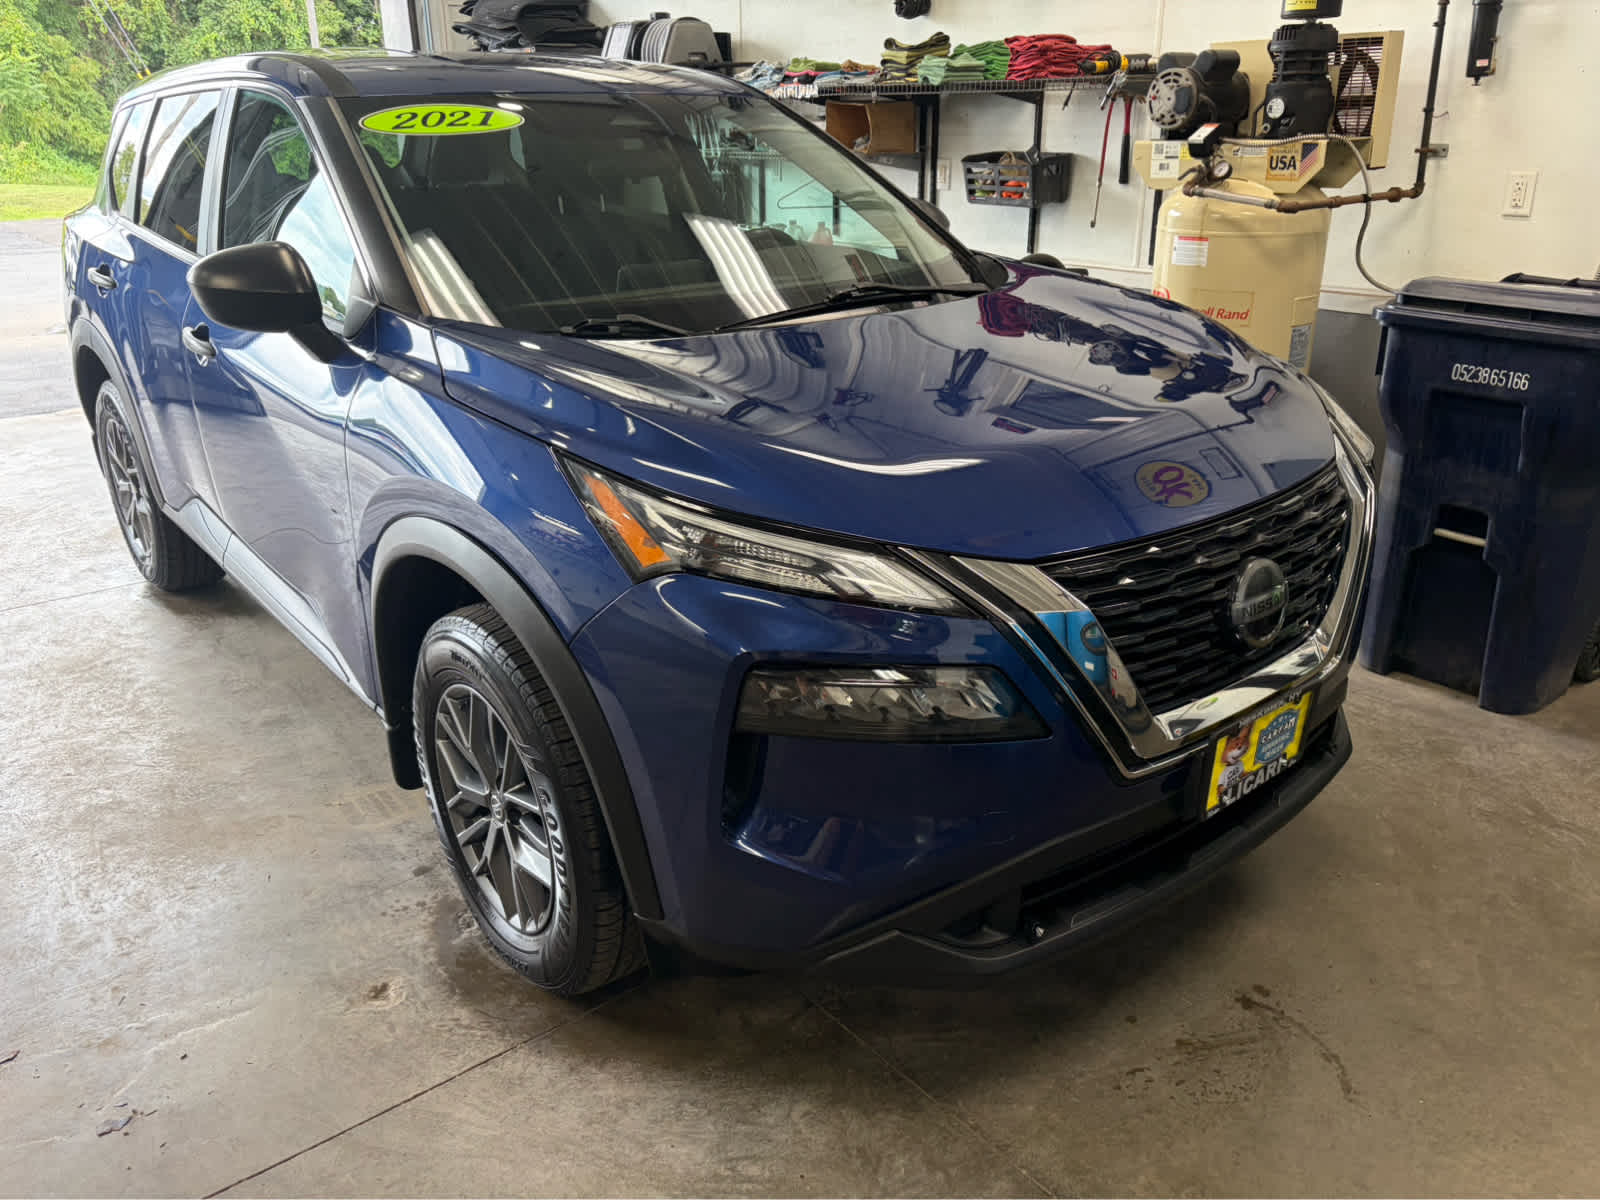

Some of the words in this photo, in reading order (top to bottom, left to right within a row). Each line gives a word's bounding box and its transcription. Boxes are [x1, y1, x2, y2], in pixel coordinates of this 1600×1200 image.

[392, 110, 494, 130] 2021
[1269, 155, 1297, 171] USA
[1216, 306, 1251, 320] Rand
[1451, 363, 1531, 391] 0523865166
